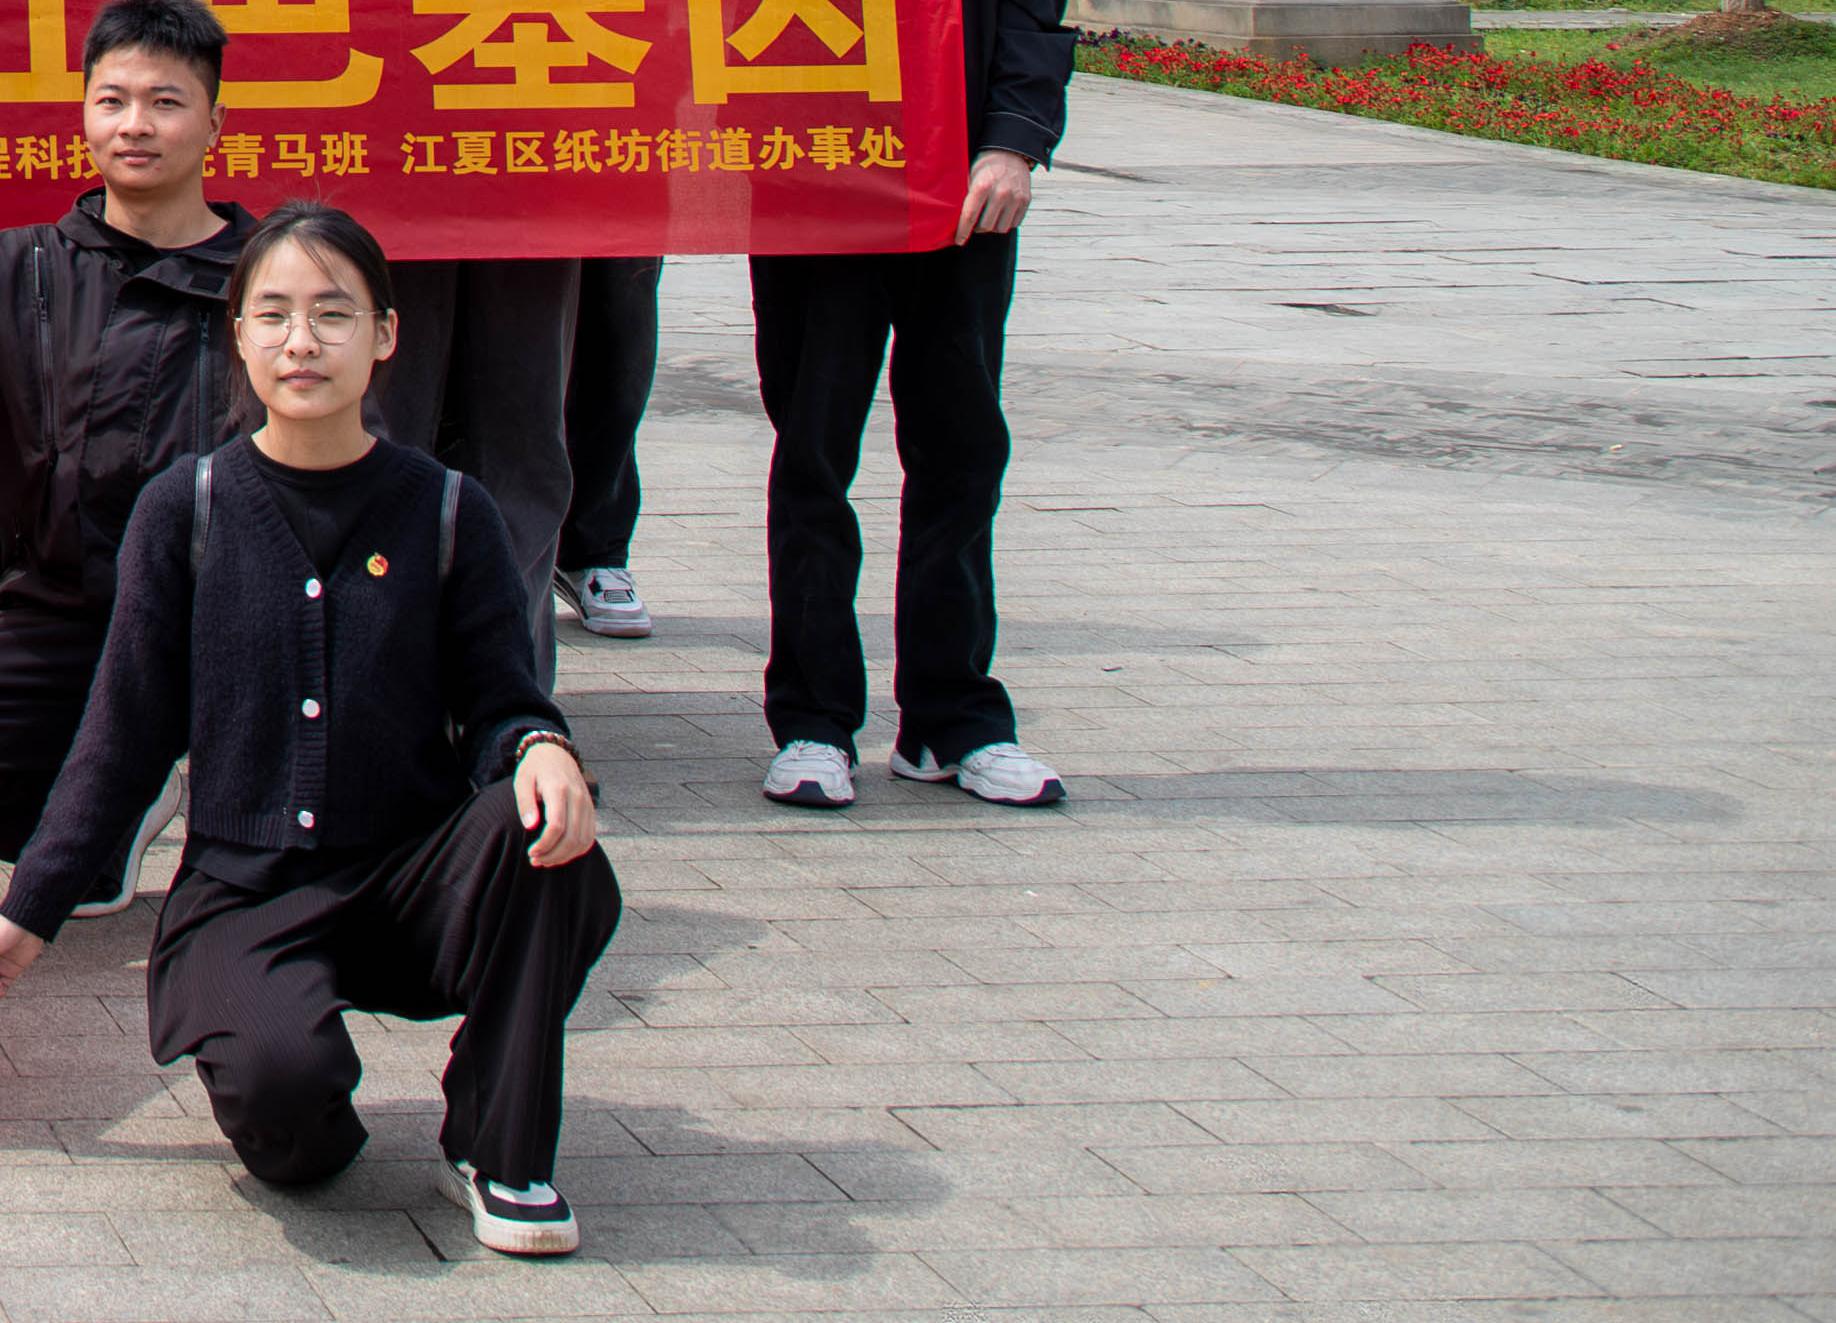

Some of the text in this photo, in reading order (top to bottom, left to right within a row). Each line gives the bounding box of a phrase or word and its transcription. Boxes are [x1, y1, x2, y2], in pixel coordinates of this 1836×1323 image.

[400, 125, 906, 175] 江夏区纸坊街道办事处
